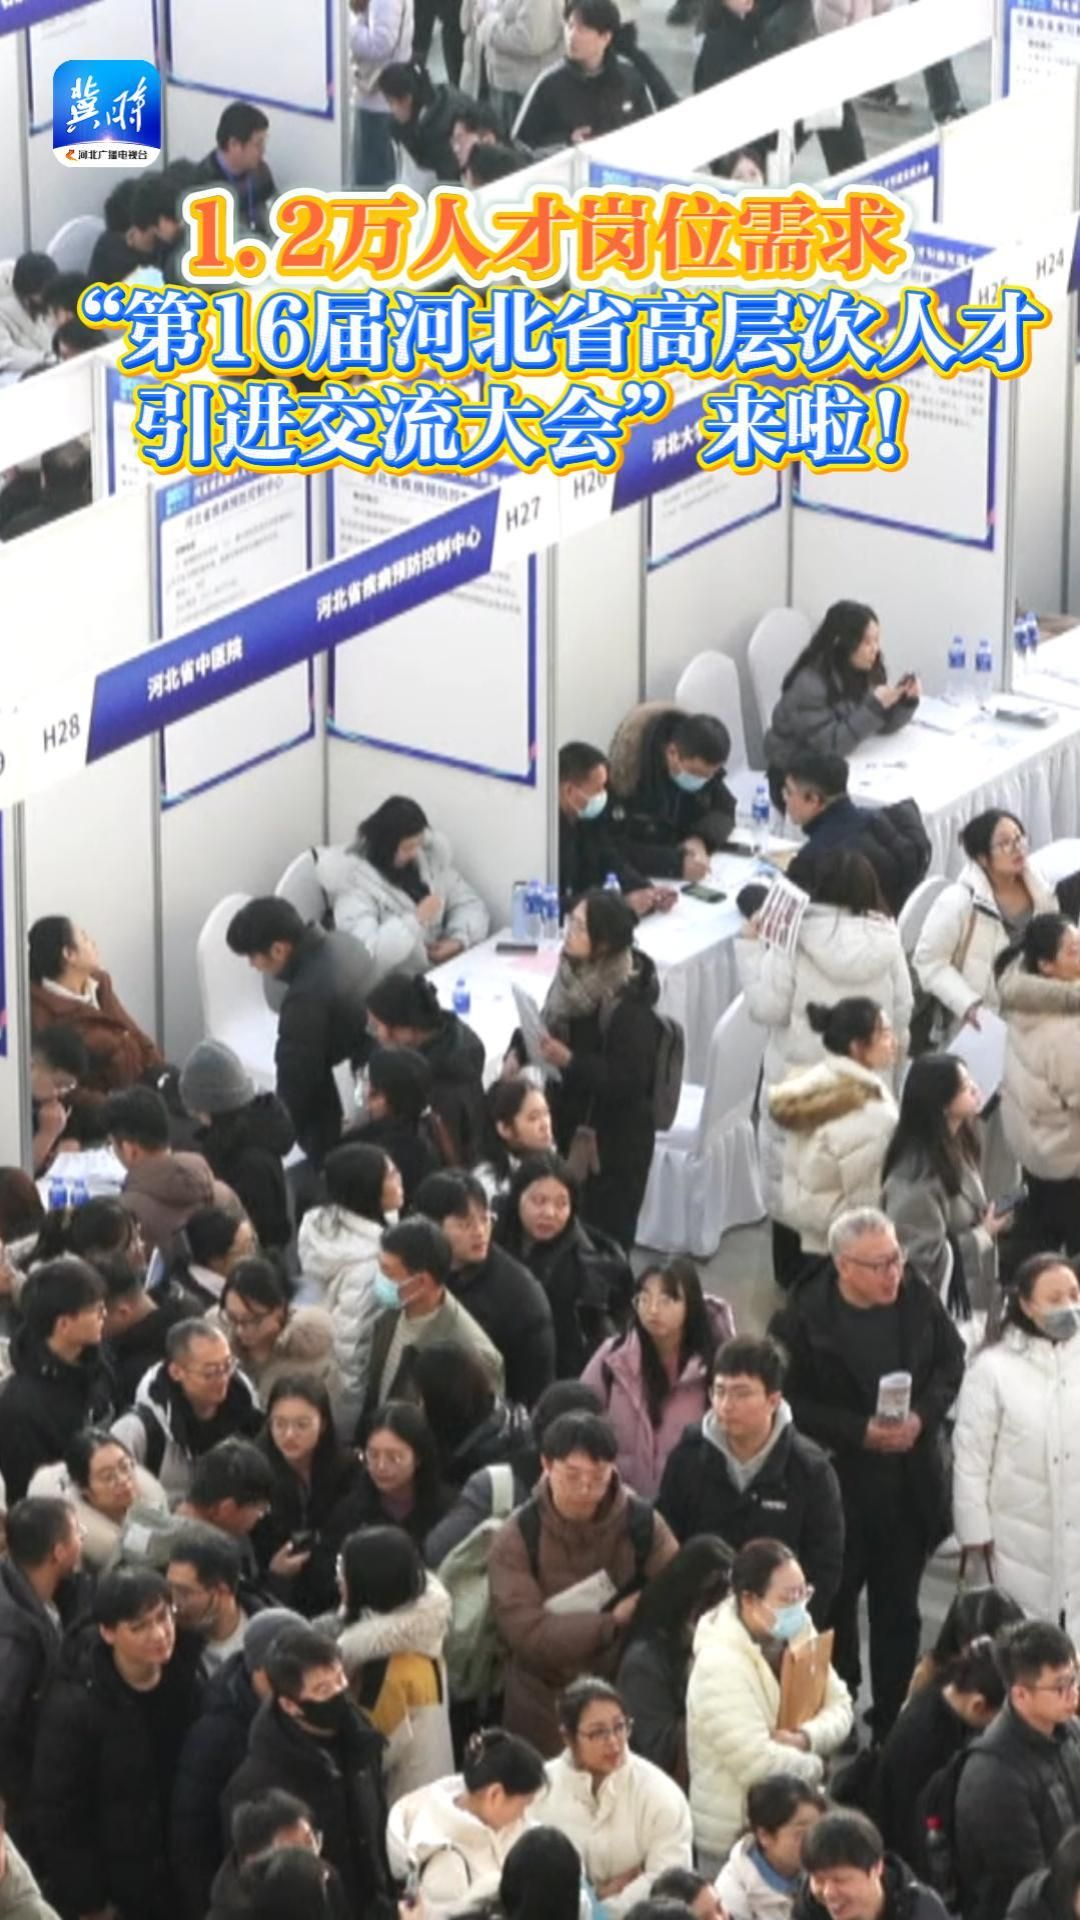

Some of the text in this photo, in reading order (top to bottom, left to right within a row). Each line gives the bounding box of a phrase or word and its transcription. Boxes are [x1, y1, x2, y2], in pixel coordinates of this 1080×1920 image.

[1035, 248, 1065, 280] H24
[505, 496, 542, 533] H27
[315, 524, 482, 623] 河北省疾病预防控制中心
[146, 634, 244, 702] 河北省中医院
[42, 713, 81, 754] H28
